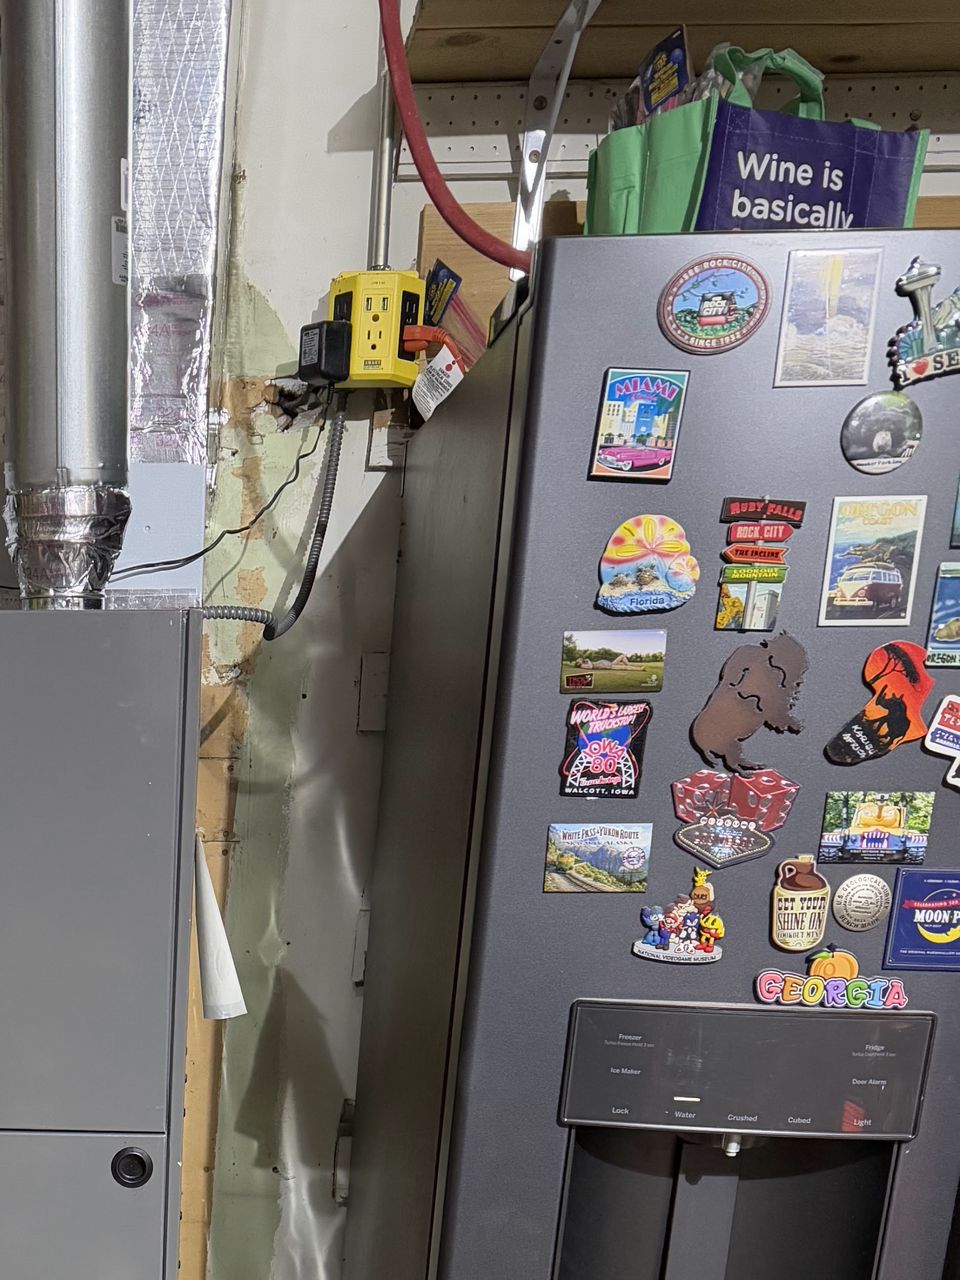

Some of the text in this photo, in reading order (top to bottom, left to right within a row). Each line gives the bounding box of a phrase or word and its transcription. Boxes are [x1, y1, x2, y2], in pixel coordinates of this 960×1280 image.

[737, 151, 844, 191] Wine is
[731, 189, 854, 229] basically
[703, 259, 730, 269] ROCK
[731, 259, 753, 274] CITY
[702, 307, 725, 316] CITY
[689, 337, 716, 347] SINCE
[615, 377, 680, 402] MIAMI
[729, 501, 803, 521] RUBY FALLS
[840, 502, 918, 517] OREGON
[862, 517, 893, 526] COAST
[736, 525, 785, 539] ROCK CITY
[750, 549, 780, 558] INCLINE
[629, 596, 665, 607] Florida
[569, 703, 647, 725] WORLD'S LARGEST
[587, 714, 637, 734] TRUCKSTOP!
[581, 738, 626, 760] IOWA
[589, 756, 617, 774] 80
[565, 787, 635, 796] WALCOTT, IOWA
[562, 830, 581, 841] WHITE
[581, 827, 597, 839] PASS
[599, 826, 620, 838] YUKON
[619, 829, 640, 840] ROUTE
[777, 896, 826, 911] GET YOUR
[777, 911, 823, 931] SHINE ON
[637, 948, 660, 959] NATIONAL
[693, 954, 717, 962] MUSEUM
[758, 971, 907, 1008] GEORGIA
[618, 1033, 642, 1041] Freezer
[865, 1044, 885, 1052] Fridge
[675, 1111, 696, 1119] Water
[854, 1118, 872, 1126] Light
